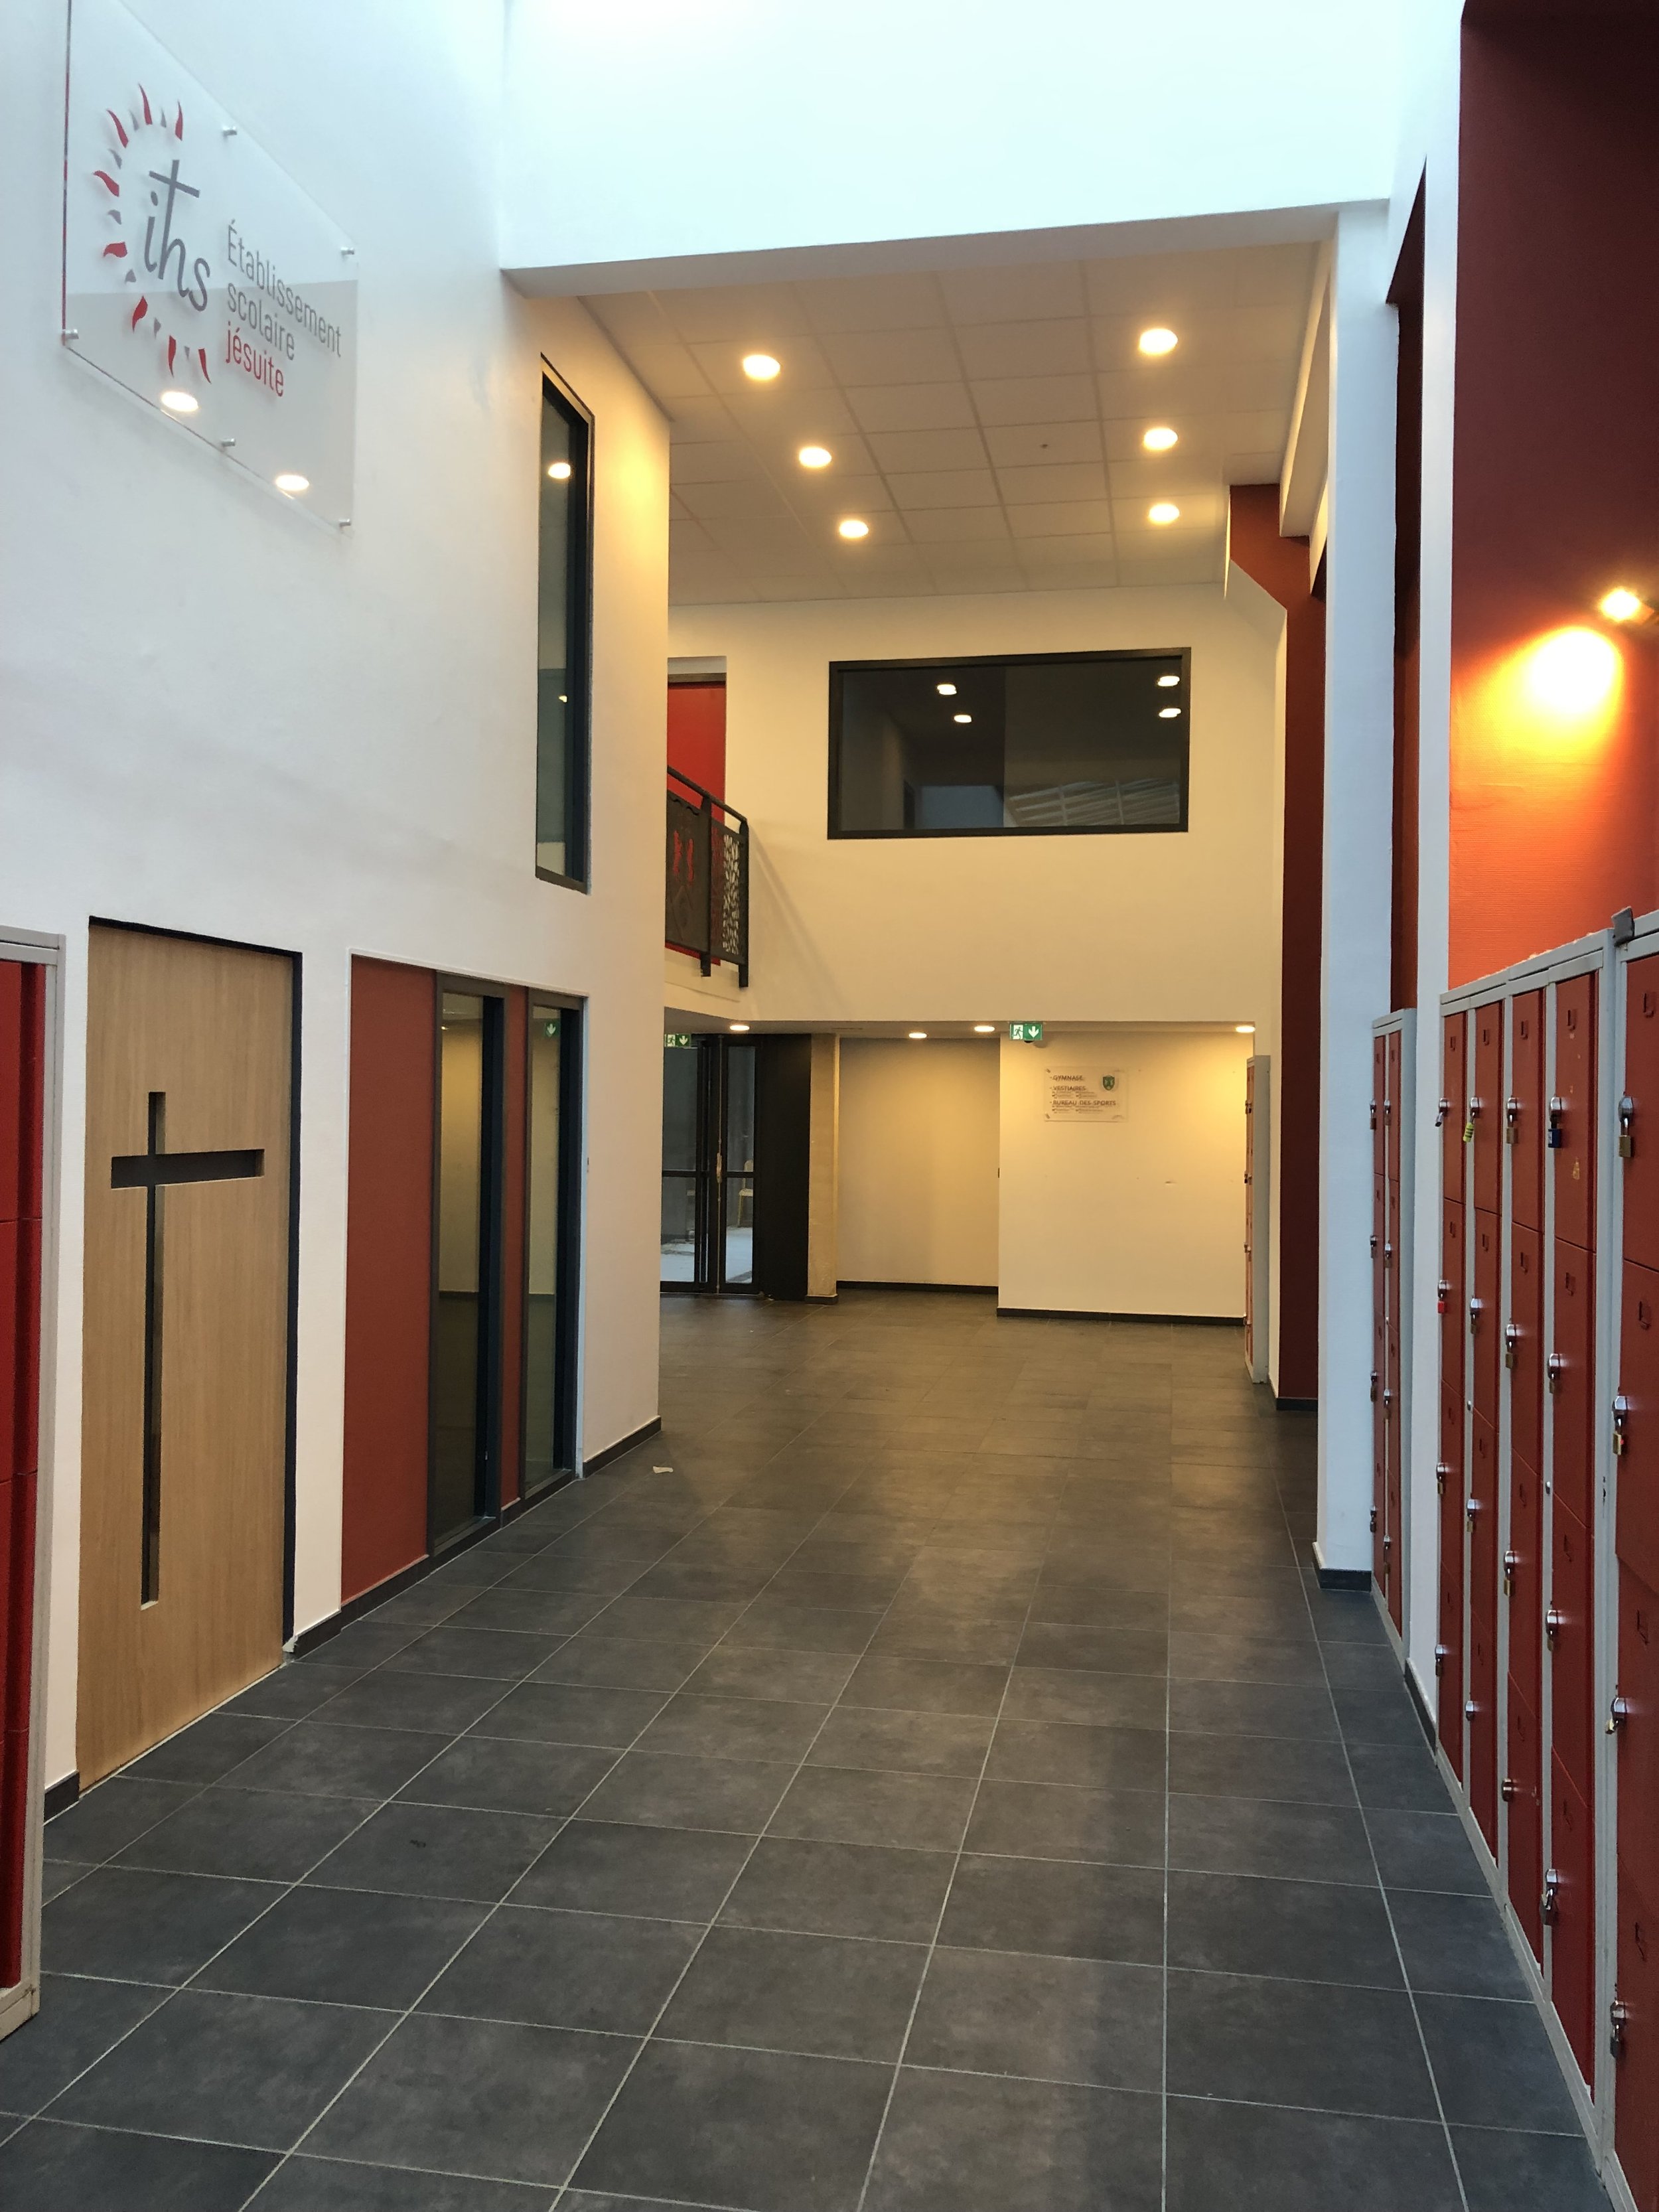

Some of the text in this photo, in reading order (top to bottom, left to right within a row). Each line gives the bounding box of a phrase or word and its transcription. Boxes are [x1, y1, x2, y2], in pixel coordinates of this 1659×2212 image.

[144, 160, 210, 311] ihs
[228, 219, 341, 357] Établissement
[226, 321, 284, 397] jésuite
[228, 283, 295, 360] scolaire
